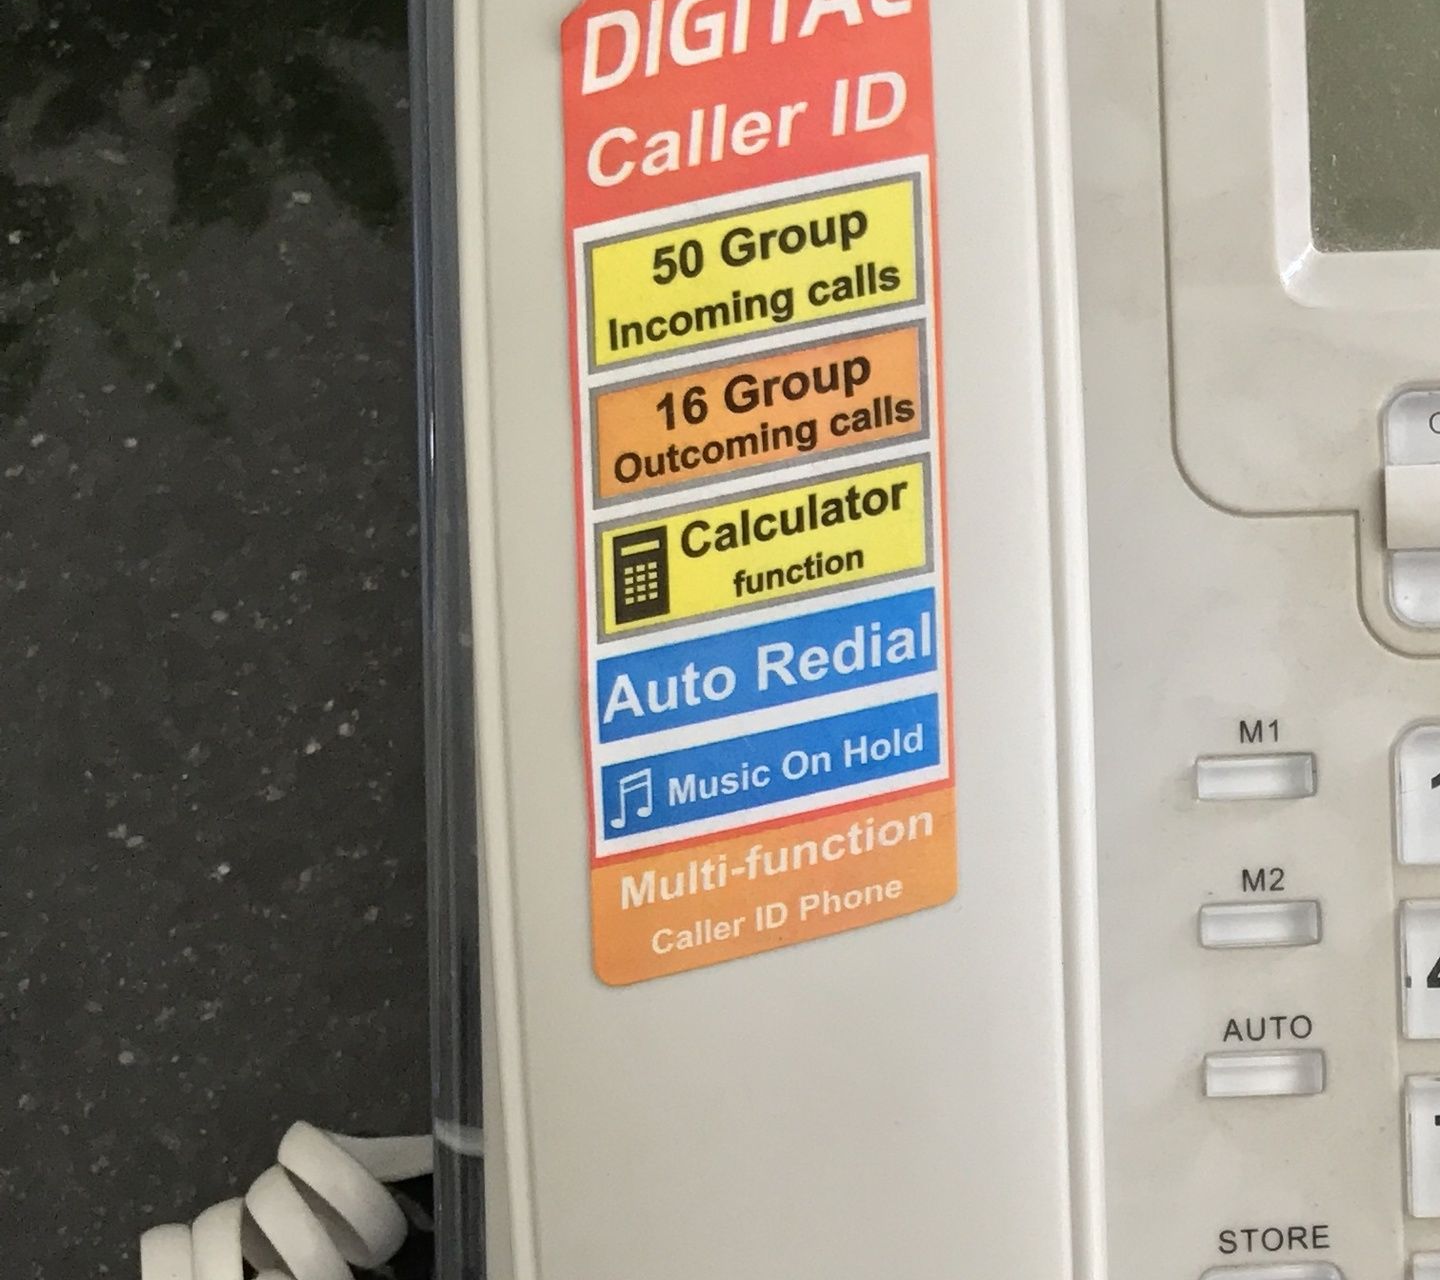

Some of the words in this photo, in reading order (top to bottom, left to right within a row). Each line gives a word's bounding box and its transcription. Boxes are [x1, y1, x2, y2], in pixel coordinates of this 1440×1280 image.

[587, 101, 807, 188] Caller
[832, 71, 907, 137] ID
[652, 240, 703, 286] 50
[721, 209, 868, 268] Group
[609, 287, 795, 352] Incoming
[808, 261, 901, 306] calls
[656, 387, 708, 431] 16
[724, 356, 871, 416] Group
[614, 416, 818, 484] Outcoming
[833, 394, 916, 436] calls
[681, 481, 908, 559] Calculator
[733, 549, 864, 597] function
[602, 664, 736, 724] Auto
[757, 612, 932, 692] Redial
[668, 757, 770, 807] Music
[782, 748, 832, 782] On
[845, 724, 924, 769] Hold
[1239, 720, 1280, 744] M1
[621, 810, 933, 911] Multi-function
[1241, 868, 1286, 891] M2
[652, 917, 745, 956] Caller
[756, 902, 788, 931] ID
[800, 878, 903, 921] Phone
[1223, 1016, 1313, 1042] AUTO
[1218, 1225, 1330, 1254] STORE
